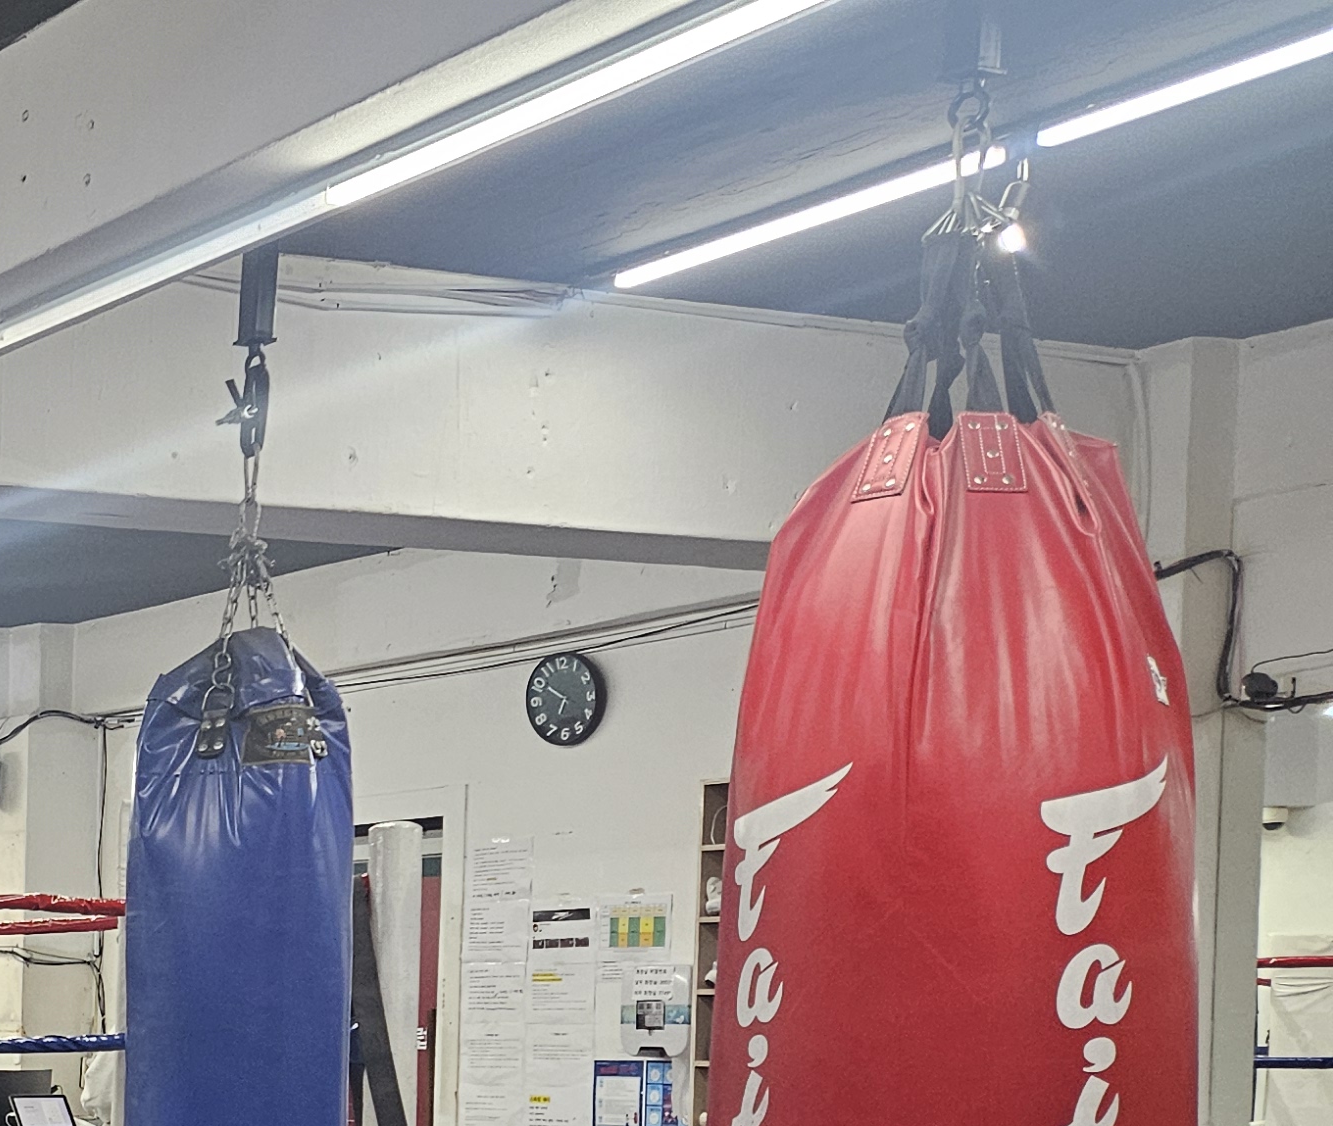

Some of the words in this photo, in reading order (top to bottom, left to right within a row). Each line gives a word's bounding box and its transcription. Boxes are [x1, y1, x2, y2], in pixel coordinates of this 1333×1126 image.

[541, 662, 555, 678] 11
[555, 656, 569, 670] 12
[531, 676, 546, 693] 10
[580, 671, 591, 685] 2
[530, 696, 542, 708] 9
[586, 690, 595, 701] 3
[535, 712, 547, 726] 8
[584, 707, 593, 720] 4
[546, 723, 558, 737] 7
[560, 727, 570, 741] 6
[574, 721, 584, 735] 5
